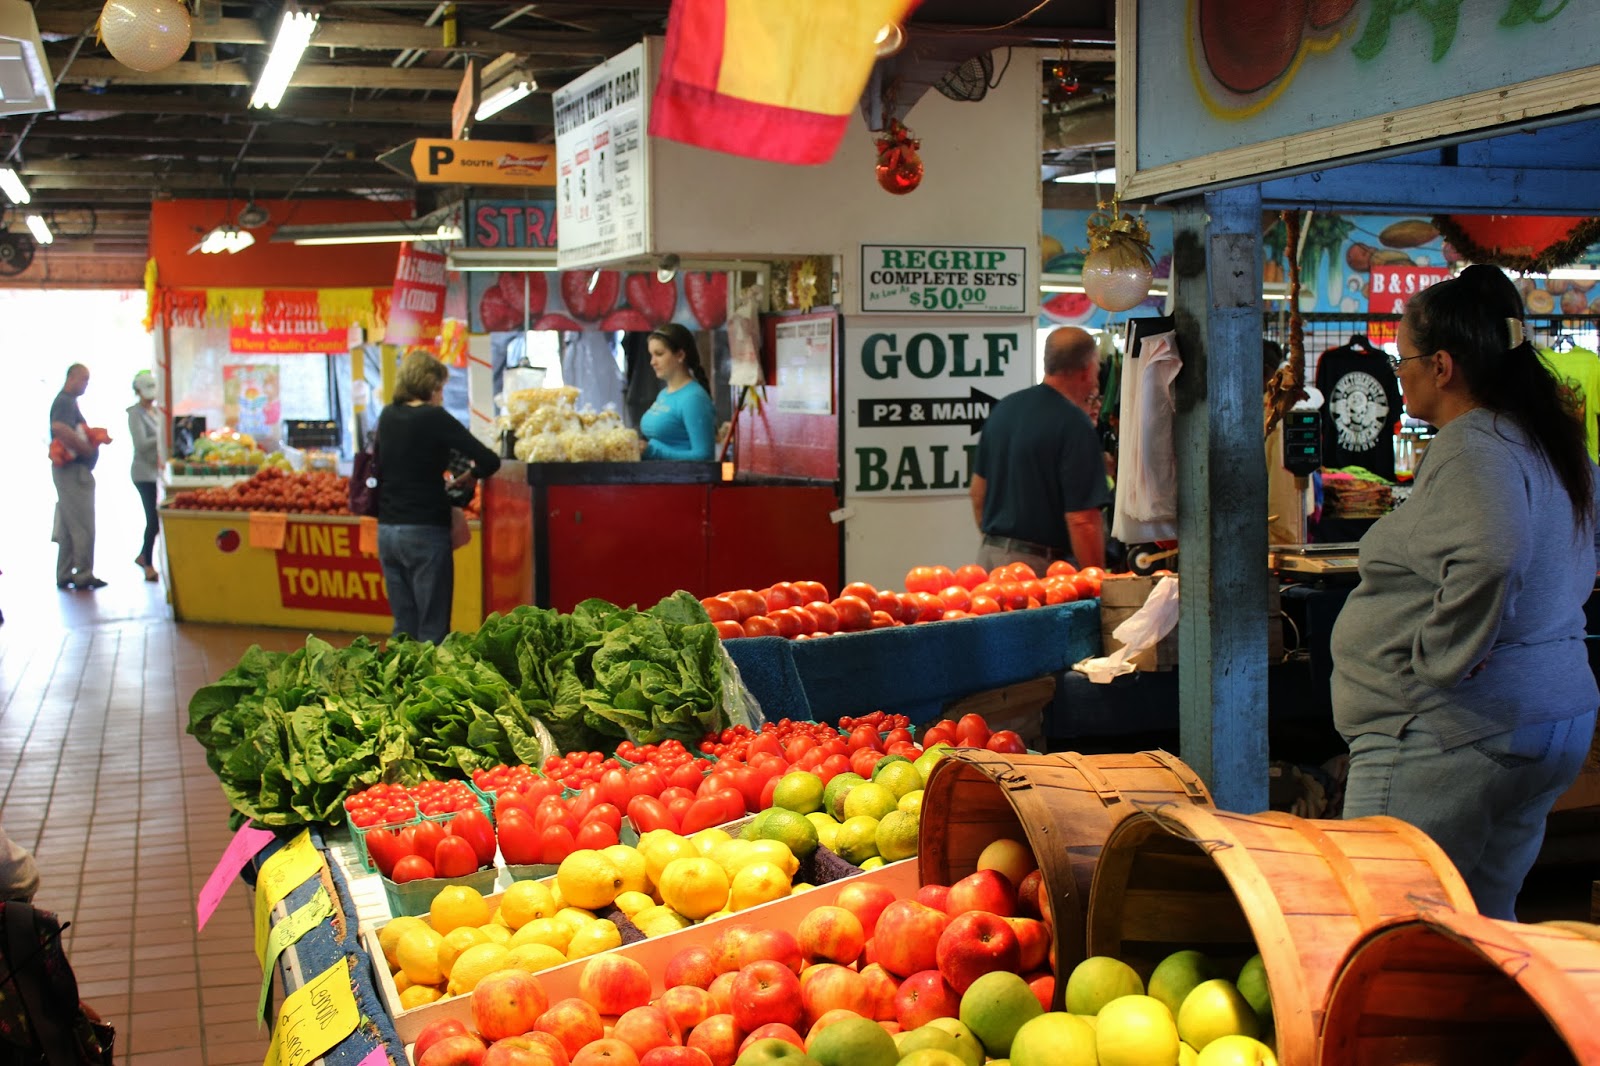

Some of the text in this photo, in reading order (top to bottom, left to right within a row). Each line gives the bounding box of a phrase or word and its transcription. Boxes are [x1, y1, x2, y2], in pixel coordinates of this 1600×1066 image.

[429, 146, 454, 175] P
[460, 159, 494, 167] SOUTH
[881, 250, 1006, 270] REGRIP
[870, 271, 968, 285] COMPLETE
[1373, 273, 1385, 293] B
[1388, 273, 1401, 294] &
[1405, 273, 1416, 294] S
[909, 287, 986, 309] $50.00
[861, 333, 1018, 380] GOLF
[873, 403, 990, 421] P2 & MAIN
[285, 525, 351, 557] VINE
[282, 566, 388, 601] TOMAT
